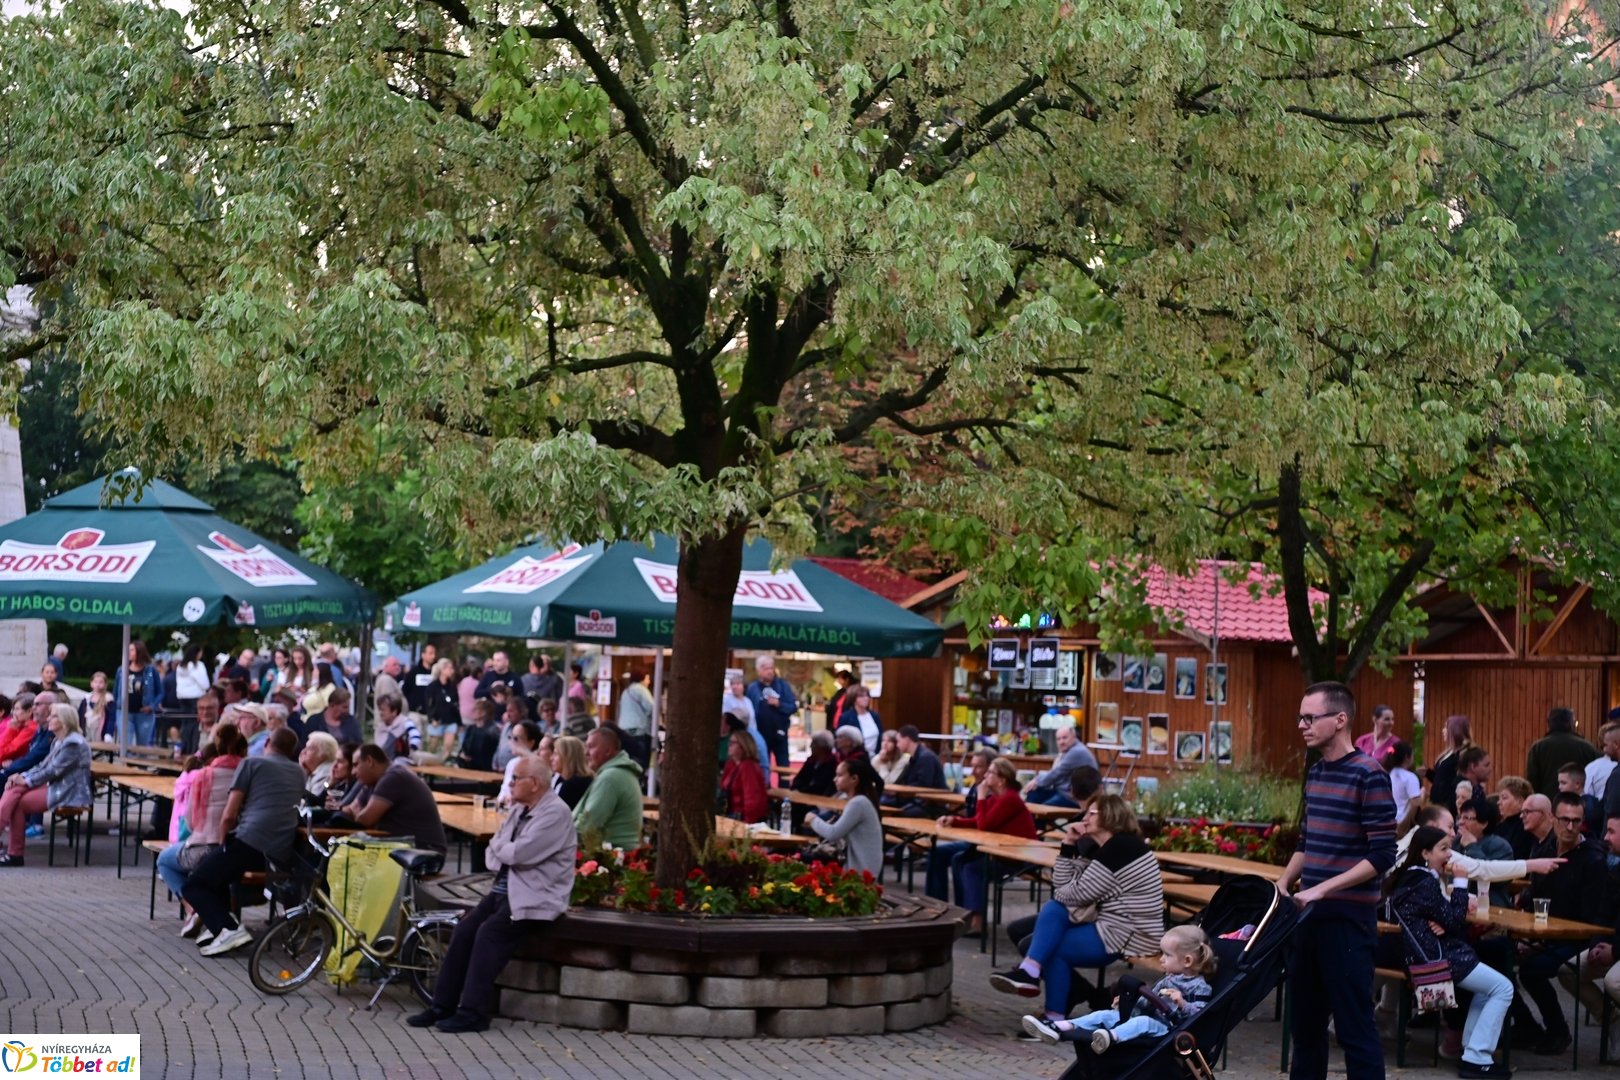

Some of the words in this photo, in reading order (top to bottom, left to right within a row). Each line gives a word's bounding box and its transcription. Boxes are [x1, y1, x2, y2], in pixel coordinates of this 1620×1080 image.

[0, 553, 138, 573] BORSODI
[11, 595, 66, 612] HABOS
[69, 597, 134, 616] OLDALA
[577, 621, 614, 633] BORSODI
